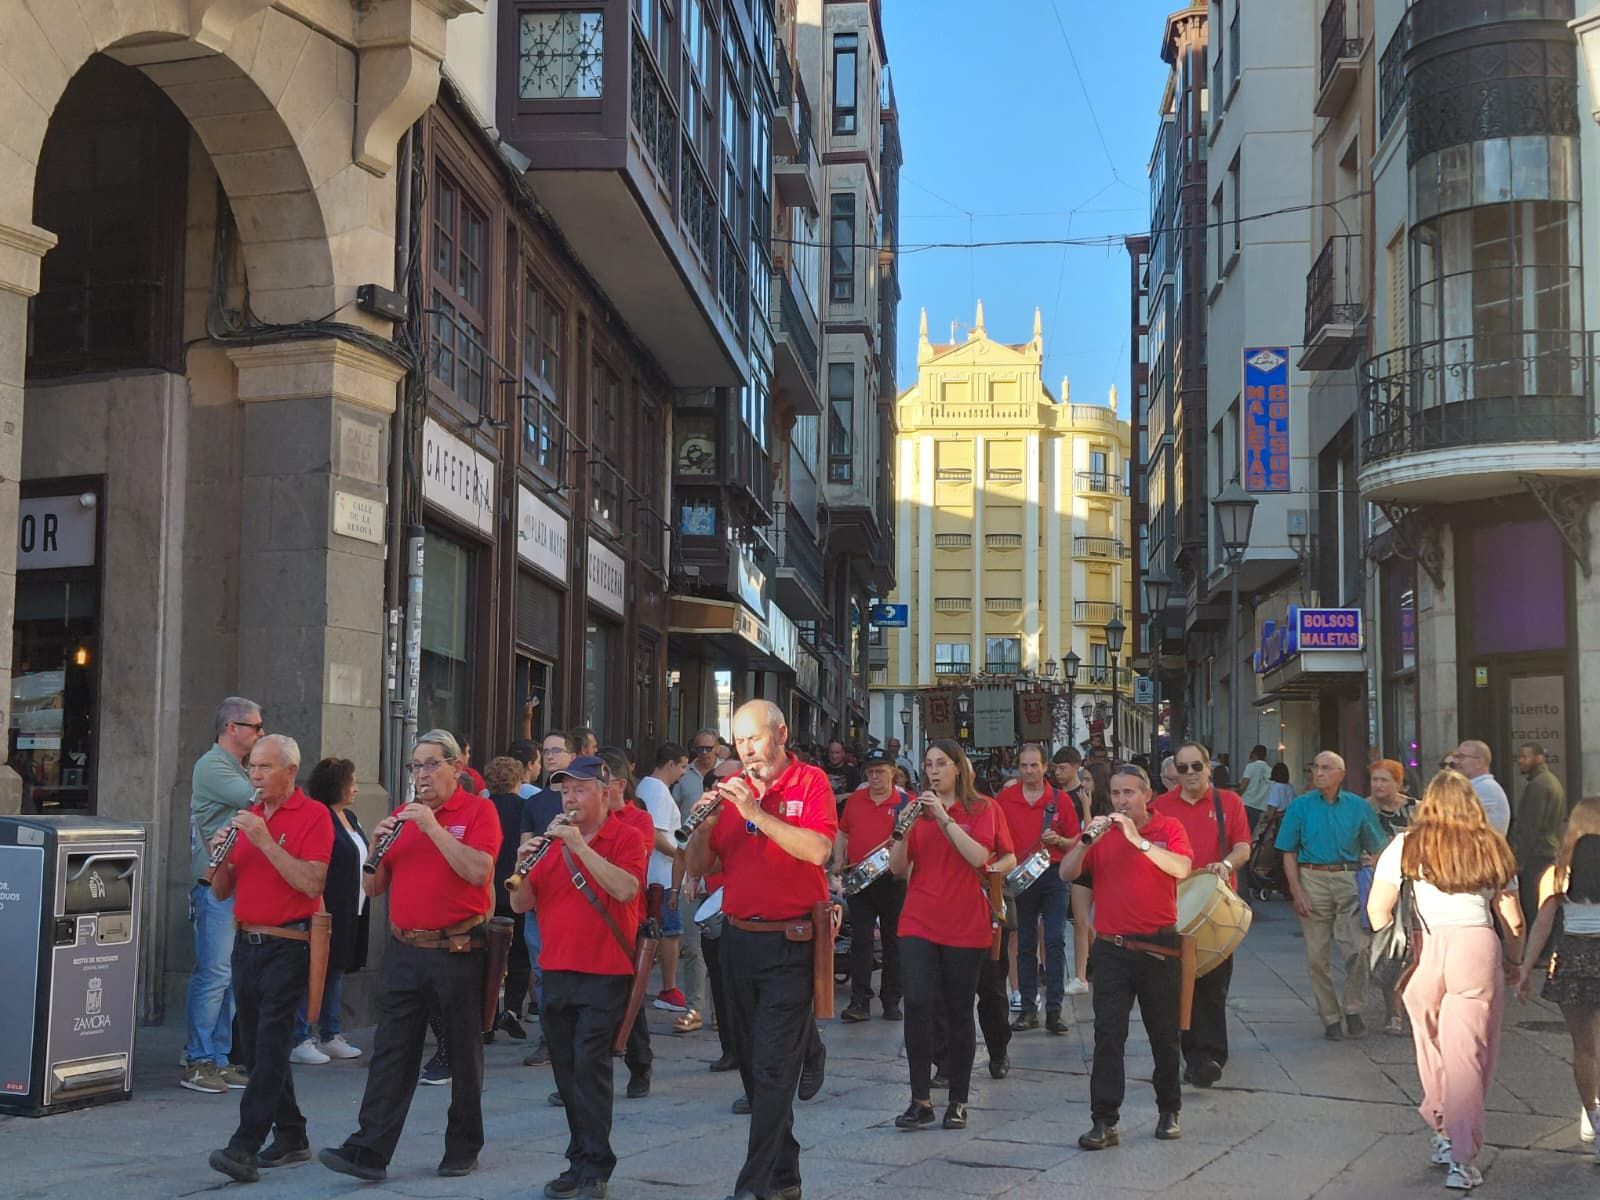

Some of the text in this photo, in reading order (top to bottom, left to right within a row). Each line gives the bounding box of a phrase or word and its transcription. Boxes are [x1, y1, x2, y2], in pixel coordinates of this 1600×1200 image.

[1248, 385, 1265, 488] MALETAS
[1268, 384, 1287, 488] BOLSOS
[352, 501, 373, 514] CALLE
[21, 513, 58, 553] OR
[531, 515, 547, 546] PLAZA
[1304, 614, 1355, 628] BOLSOS
[1301, 632, 1358, 646] MALETAS
[73, 1014, 112, 1031] ZAMORA
